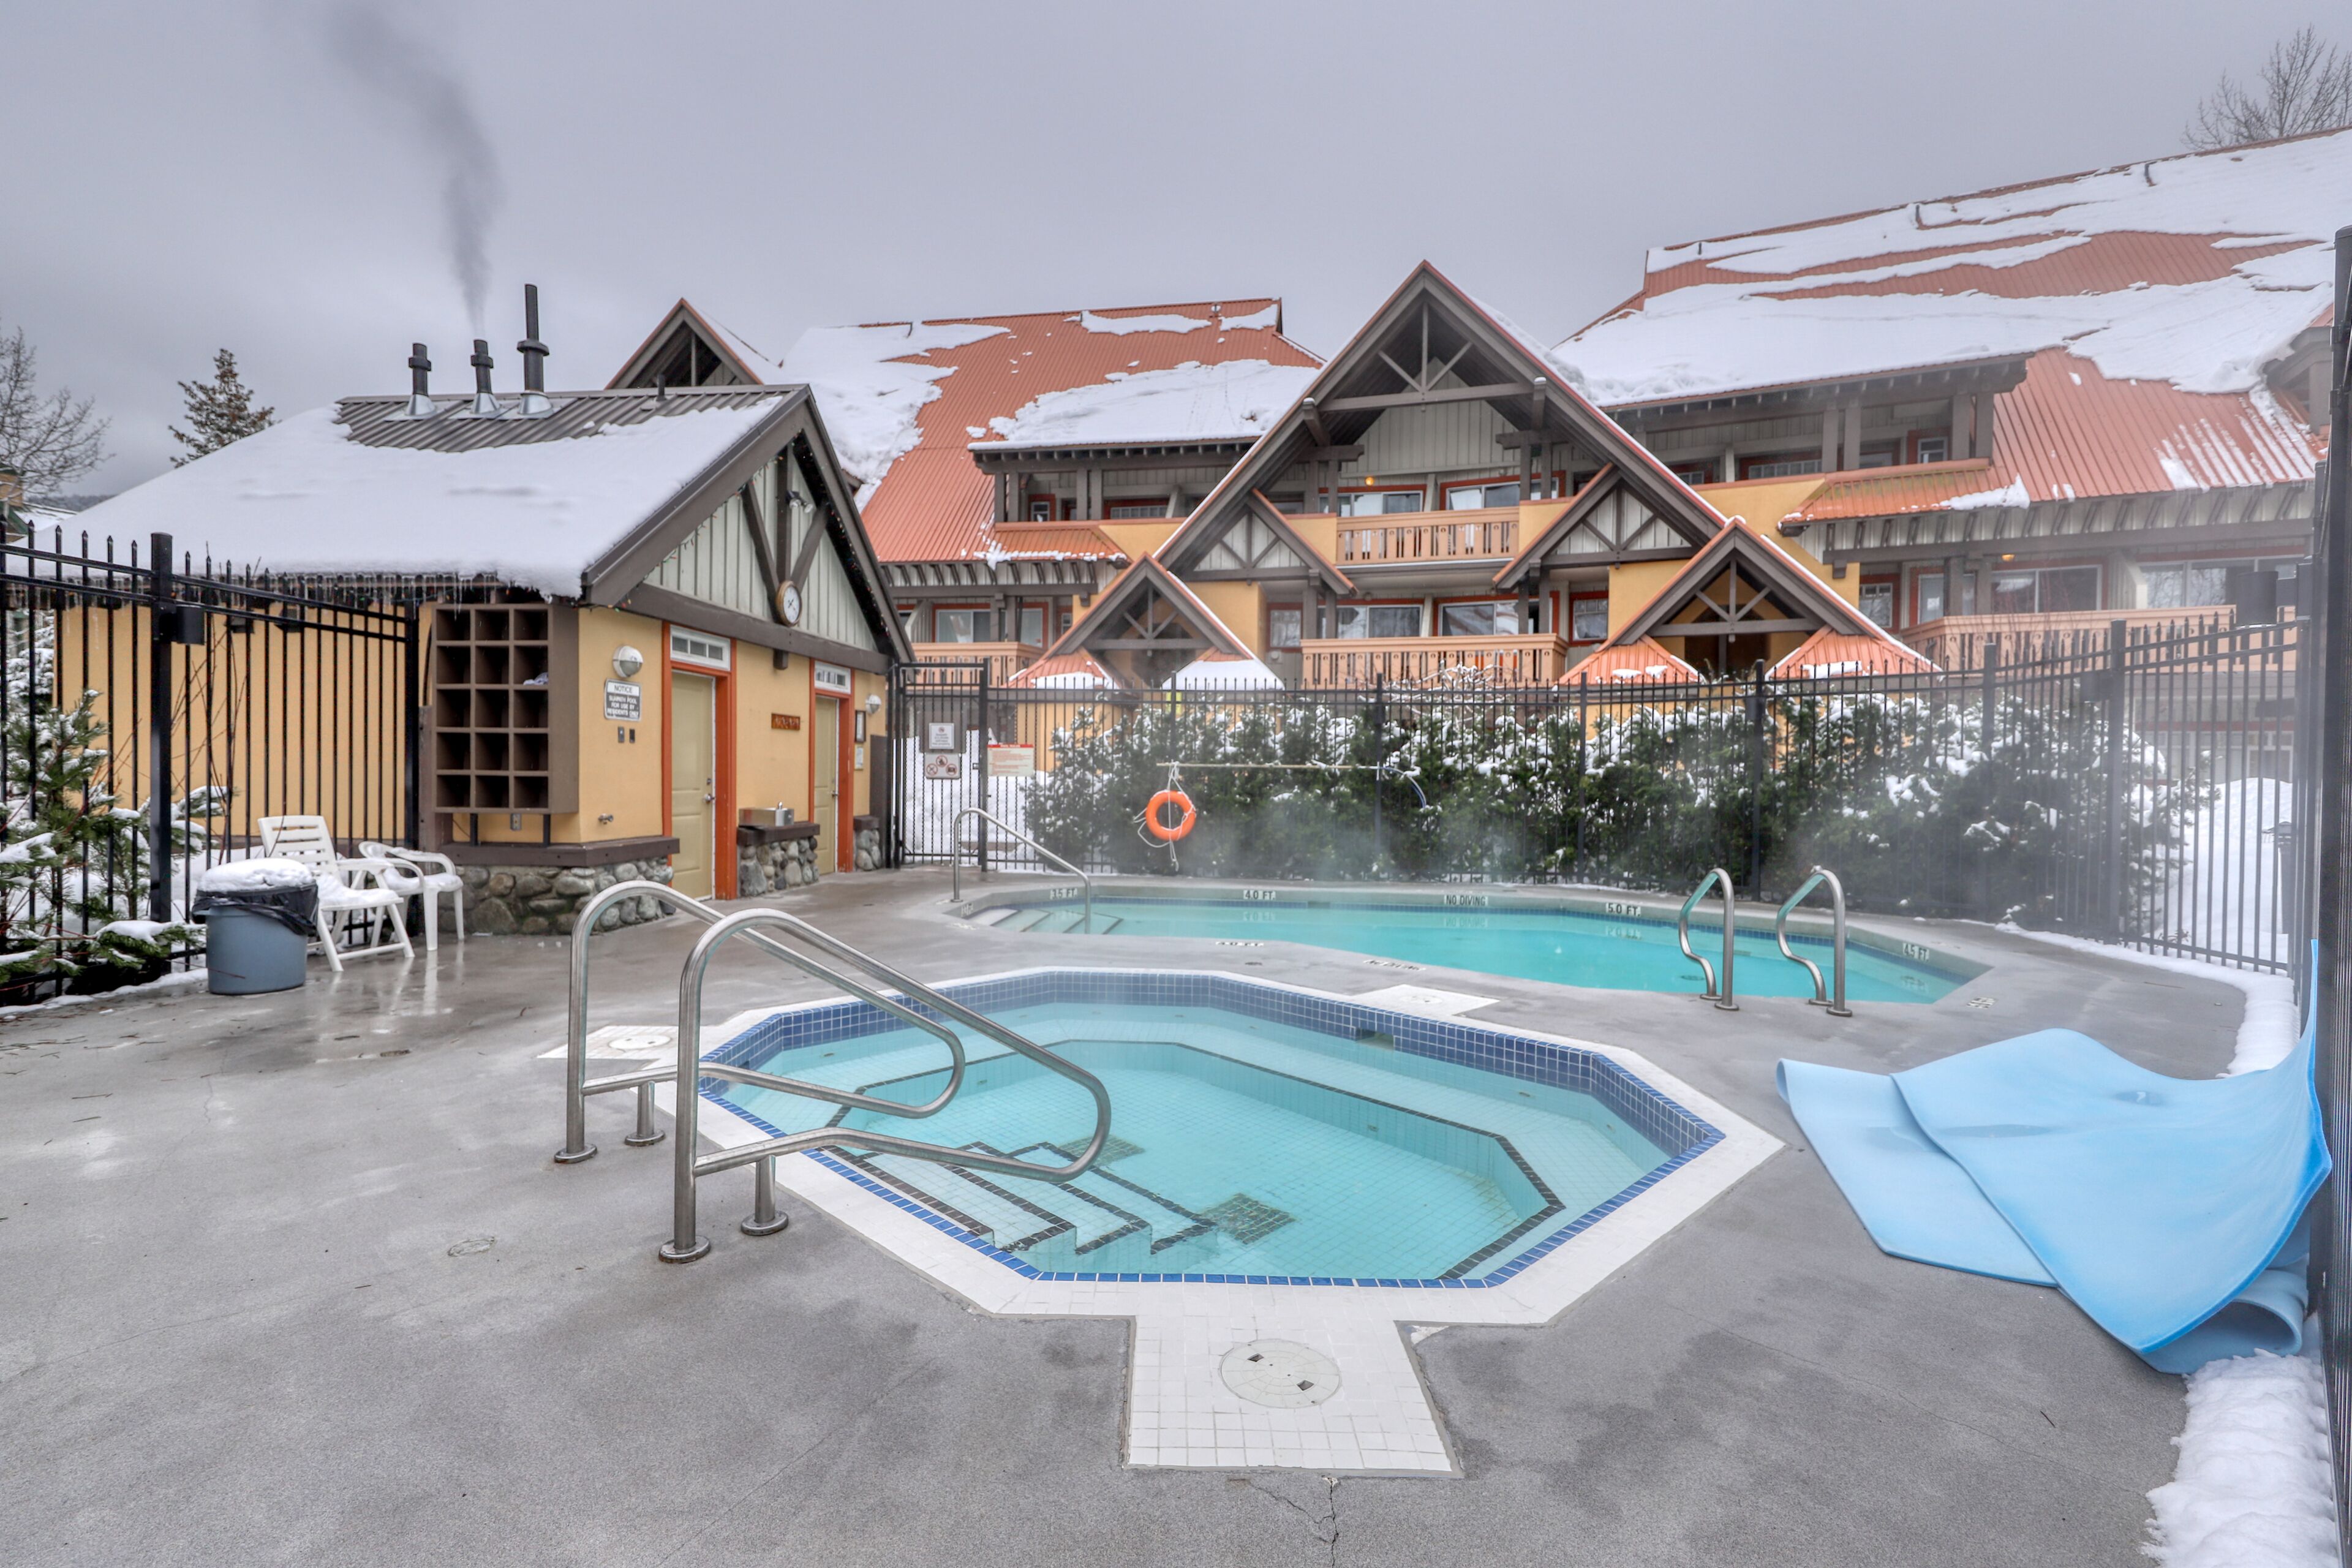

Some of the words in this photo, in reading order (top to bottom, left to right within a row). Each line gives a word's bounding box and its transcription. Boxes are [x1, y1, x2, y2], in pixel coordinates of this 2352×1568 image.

[614, 685, 633, 693] NOTICE
[1446, 895, 1457, 905] NO
[1460, 895, 1486, 906] DIVING
[1626, 905, 1641, 917] FT.
